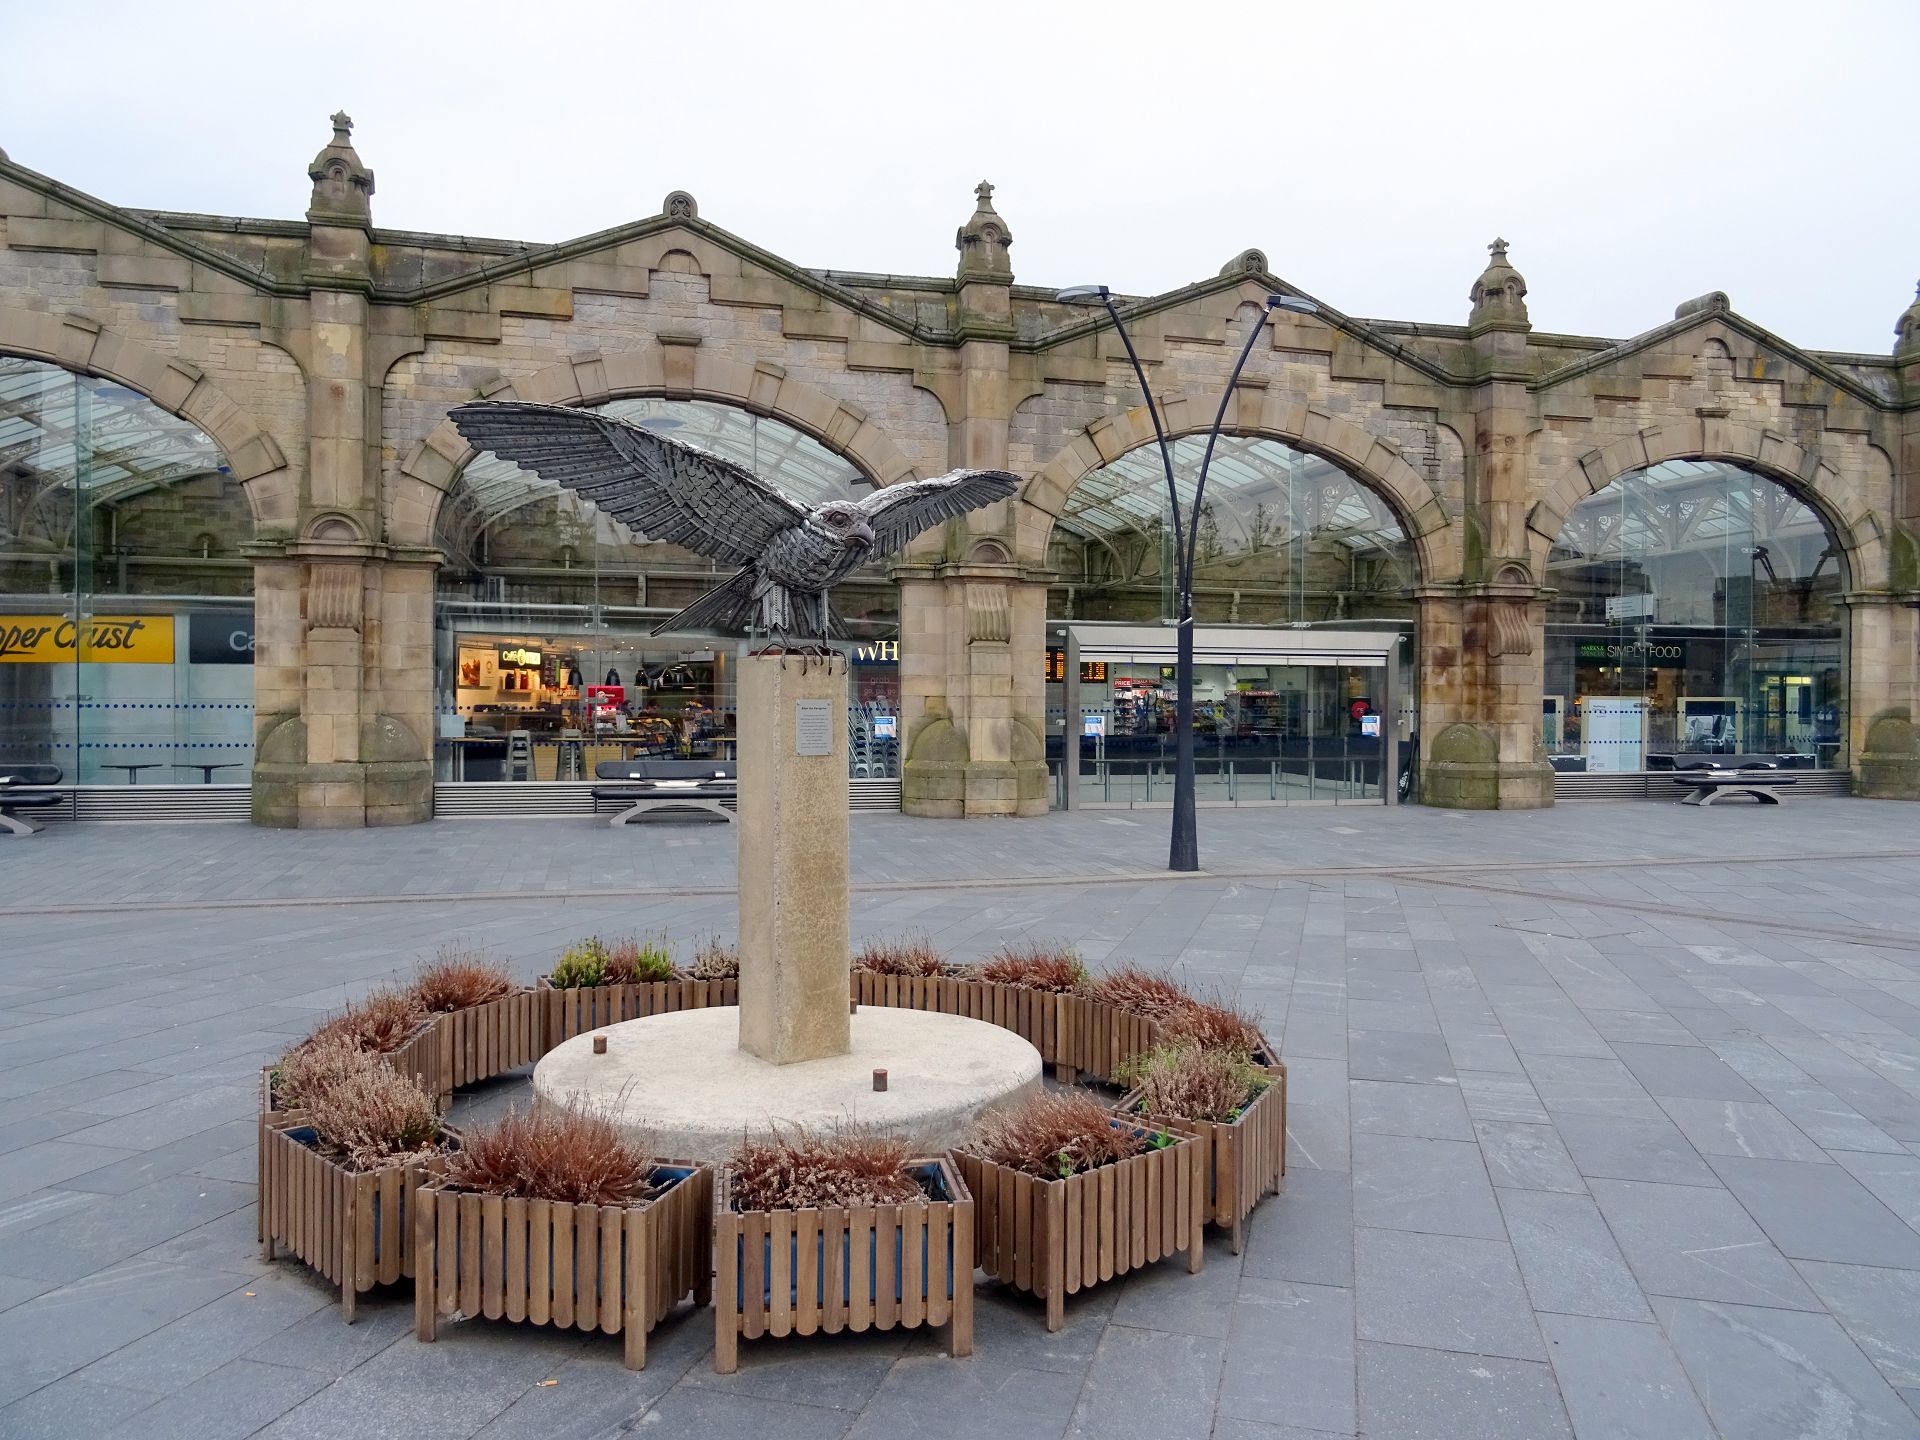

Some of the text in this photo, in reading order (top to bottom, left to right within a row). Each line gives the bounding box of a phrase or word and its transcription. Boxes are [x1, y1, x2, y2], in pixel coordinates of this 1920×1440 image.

[53, 619, 146, 649] Crust
[857, 640, 899, 661] WH
[1649, 646, 1682, 658] FOOD
